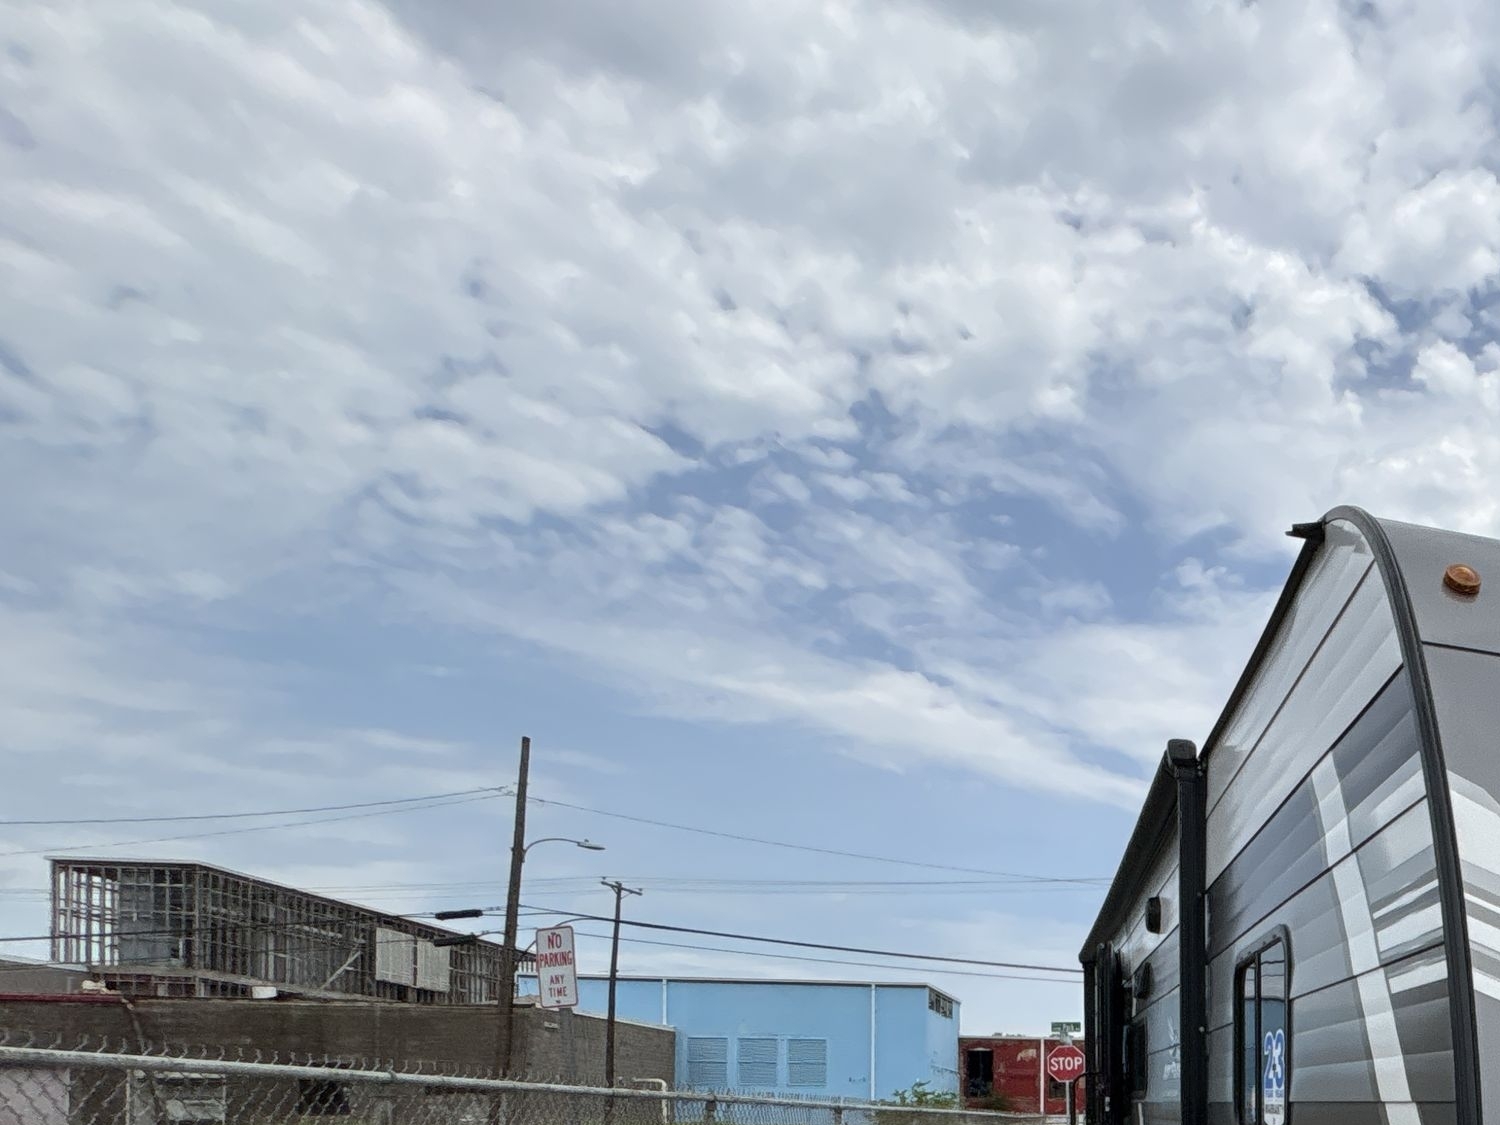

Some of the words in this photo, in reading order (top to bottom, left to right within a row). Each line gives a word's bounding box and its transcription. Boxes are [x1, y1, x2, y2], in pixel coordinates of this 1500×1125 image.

[547, 934, 562, 949] NO
[540, 951, 573, 968] PARKING
[550, 975, 565, 986] ANY
[549, 986, 568, 997] TIME
[1050, 1056, 1083, 1071] STOP
